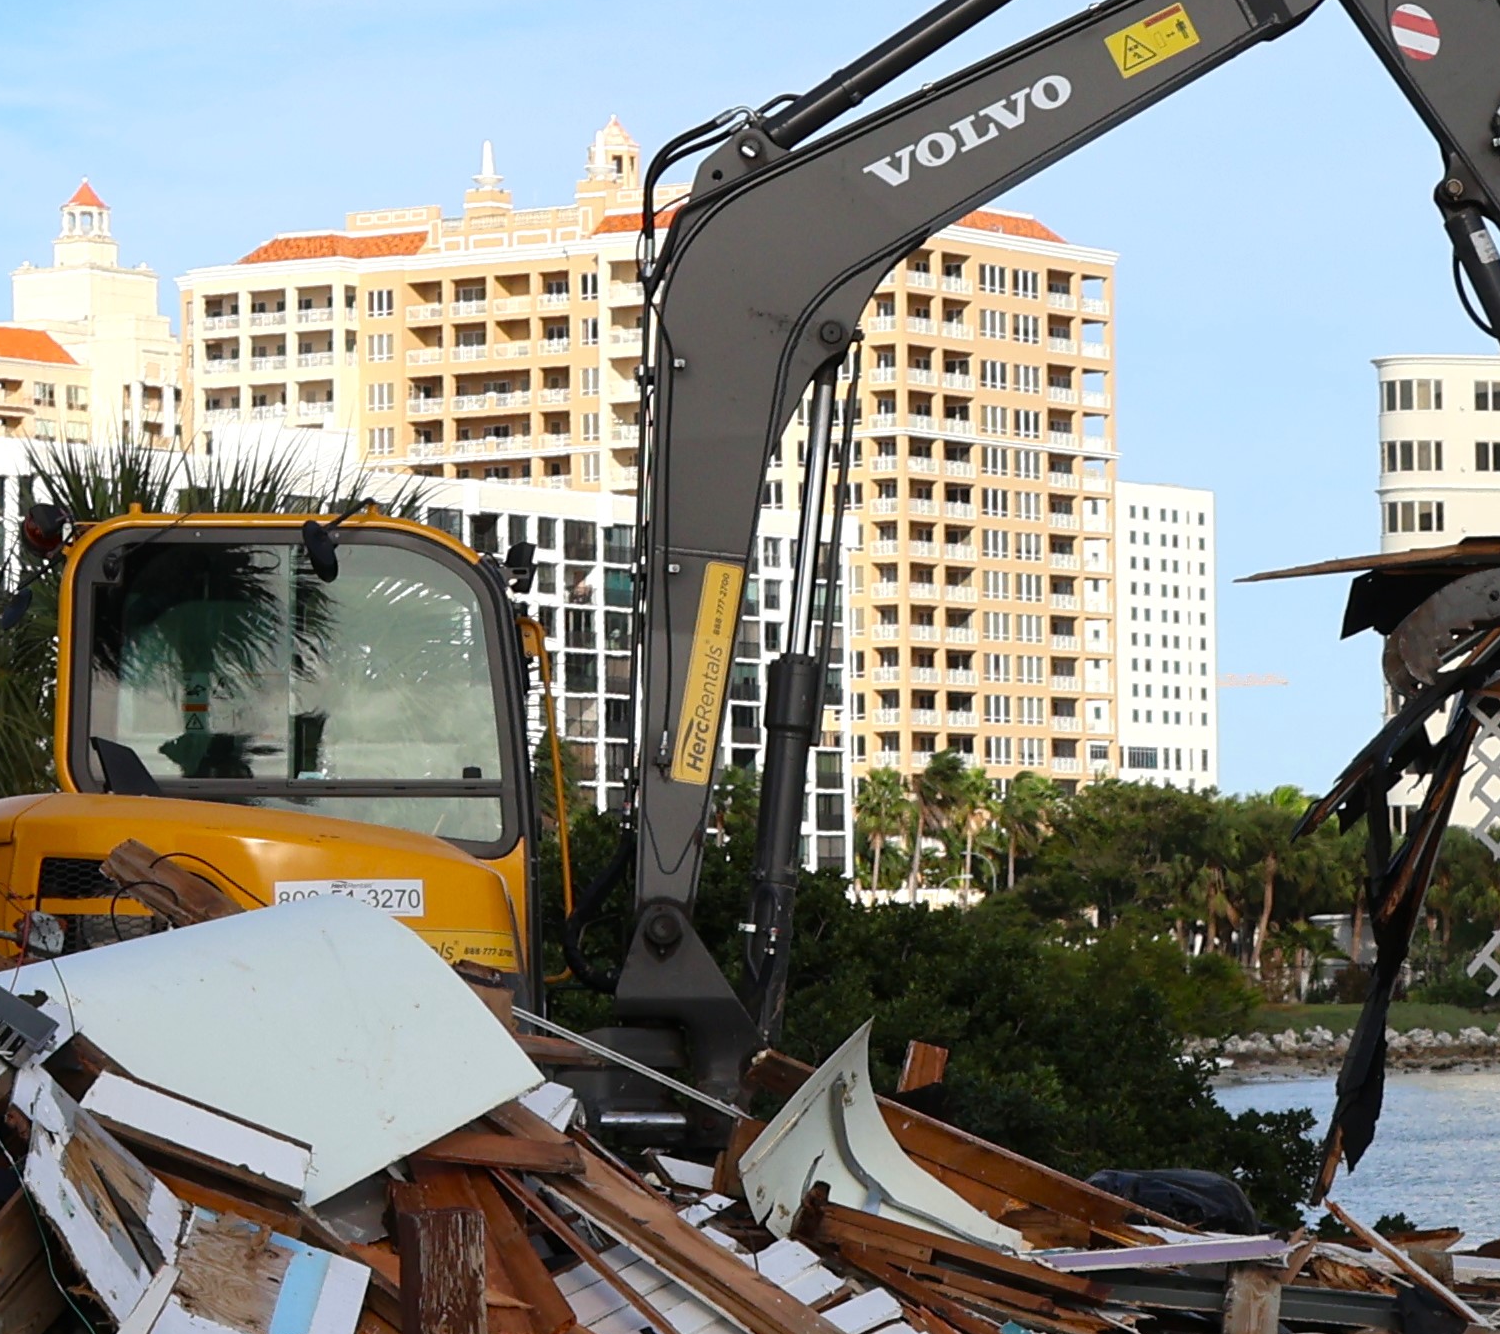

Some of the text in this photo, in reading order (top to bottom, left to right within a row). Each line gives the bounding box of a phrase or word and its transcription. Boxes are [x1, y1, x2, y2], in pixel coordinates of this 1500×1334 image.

[862, 75, 1072, 187] VOLVO
[713, 572, 730, 636] 888-777-2700
[686, 645, 723, 772] HercRentals
